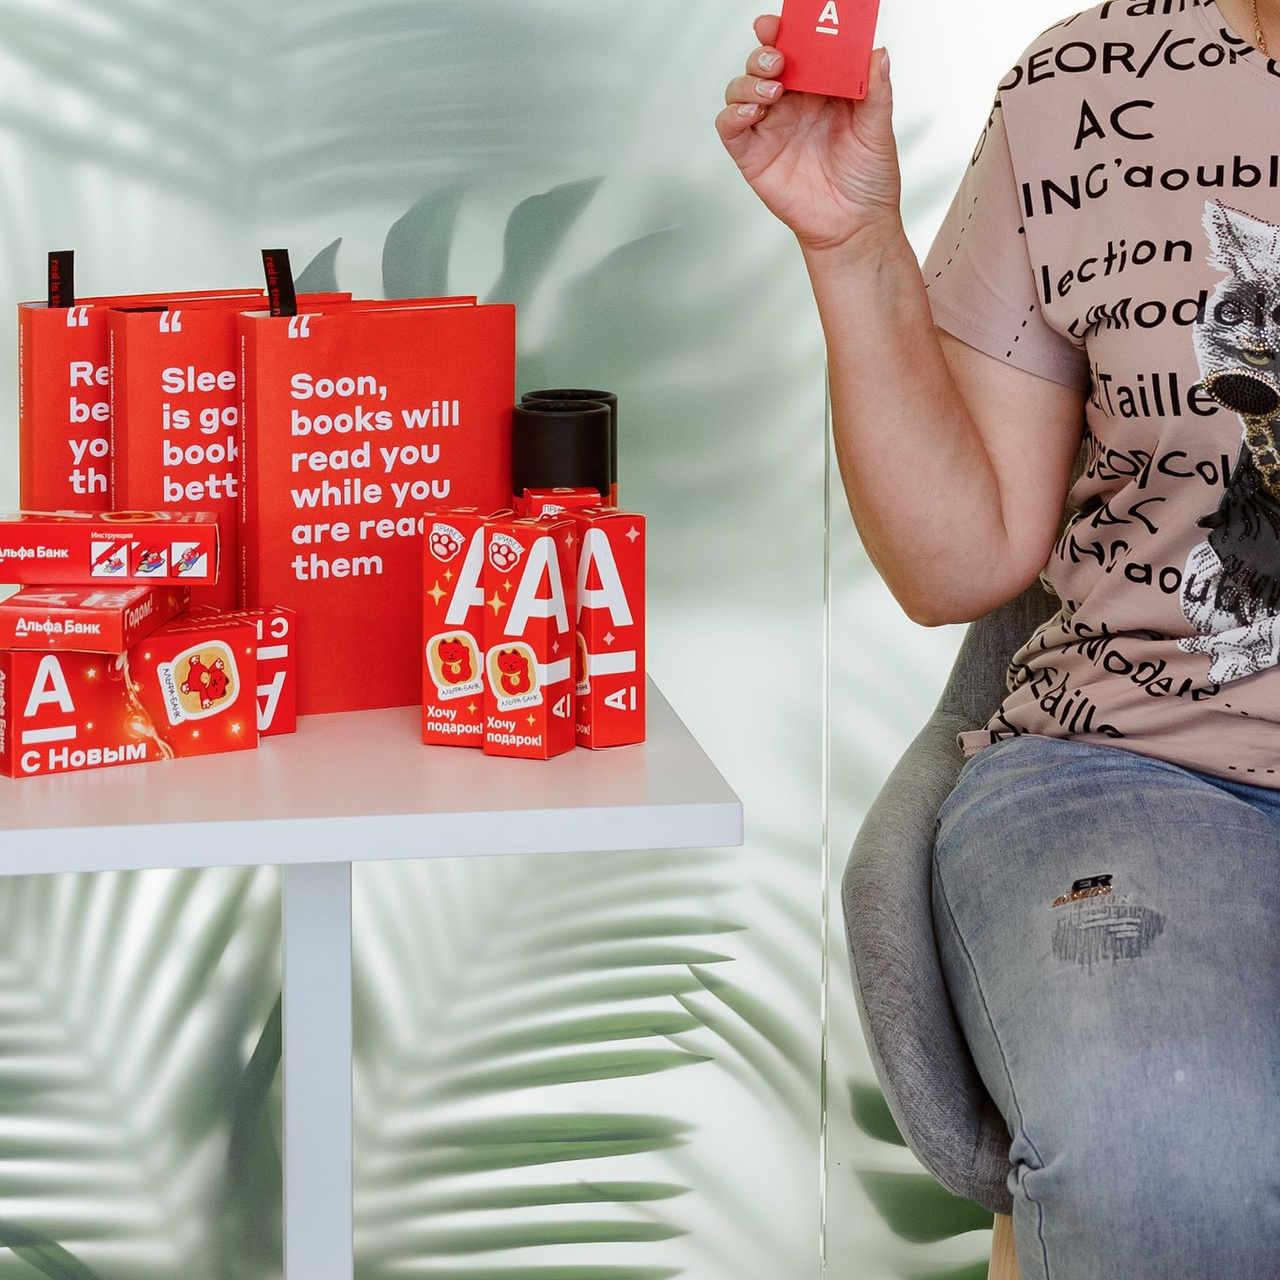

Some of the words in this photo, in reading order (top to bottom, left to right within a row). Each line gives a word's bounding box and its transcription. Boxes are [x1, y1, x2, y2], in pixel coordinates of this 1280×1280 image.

[818, 0, 839, 25] А
[1073, 98, 1155, 150] AC
[51, 258, 60, 279] red
[265, 256, 277, 275] red
[161, 365, 236, 394] Slee
[290, 372, 387, 401] Soon,
[162, 403, 190, 430] is
[291, 405, 393, 436] books
[402, 400, 460, 429] will
[291, 441, 370, 472] read
[380, 444, 440, 473] you
[69, 467, 107, 494] th
[291, 478, 382, 508] while
[390, 479, 451, 508] you
[91, 532, 133, 540] Инструкция
[291, 521, 350, 545] are
[36, 545, 69, 558] Банк
[291, 554, 383, 581] them
[124, 593, 153, 631] Годом!
[15, 618, 63, 634] Альфа
[64, 619, 101, 634] Банк
[23, 655, 75, 717] А
[427, 705, 457, 720] Хочу
[487, 716, 516, 732] Хочу
[427, 722, 483, 735] подарок!
[487, 732, 542, 747] подарок!
[49, 743, 147, 770] Новым
